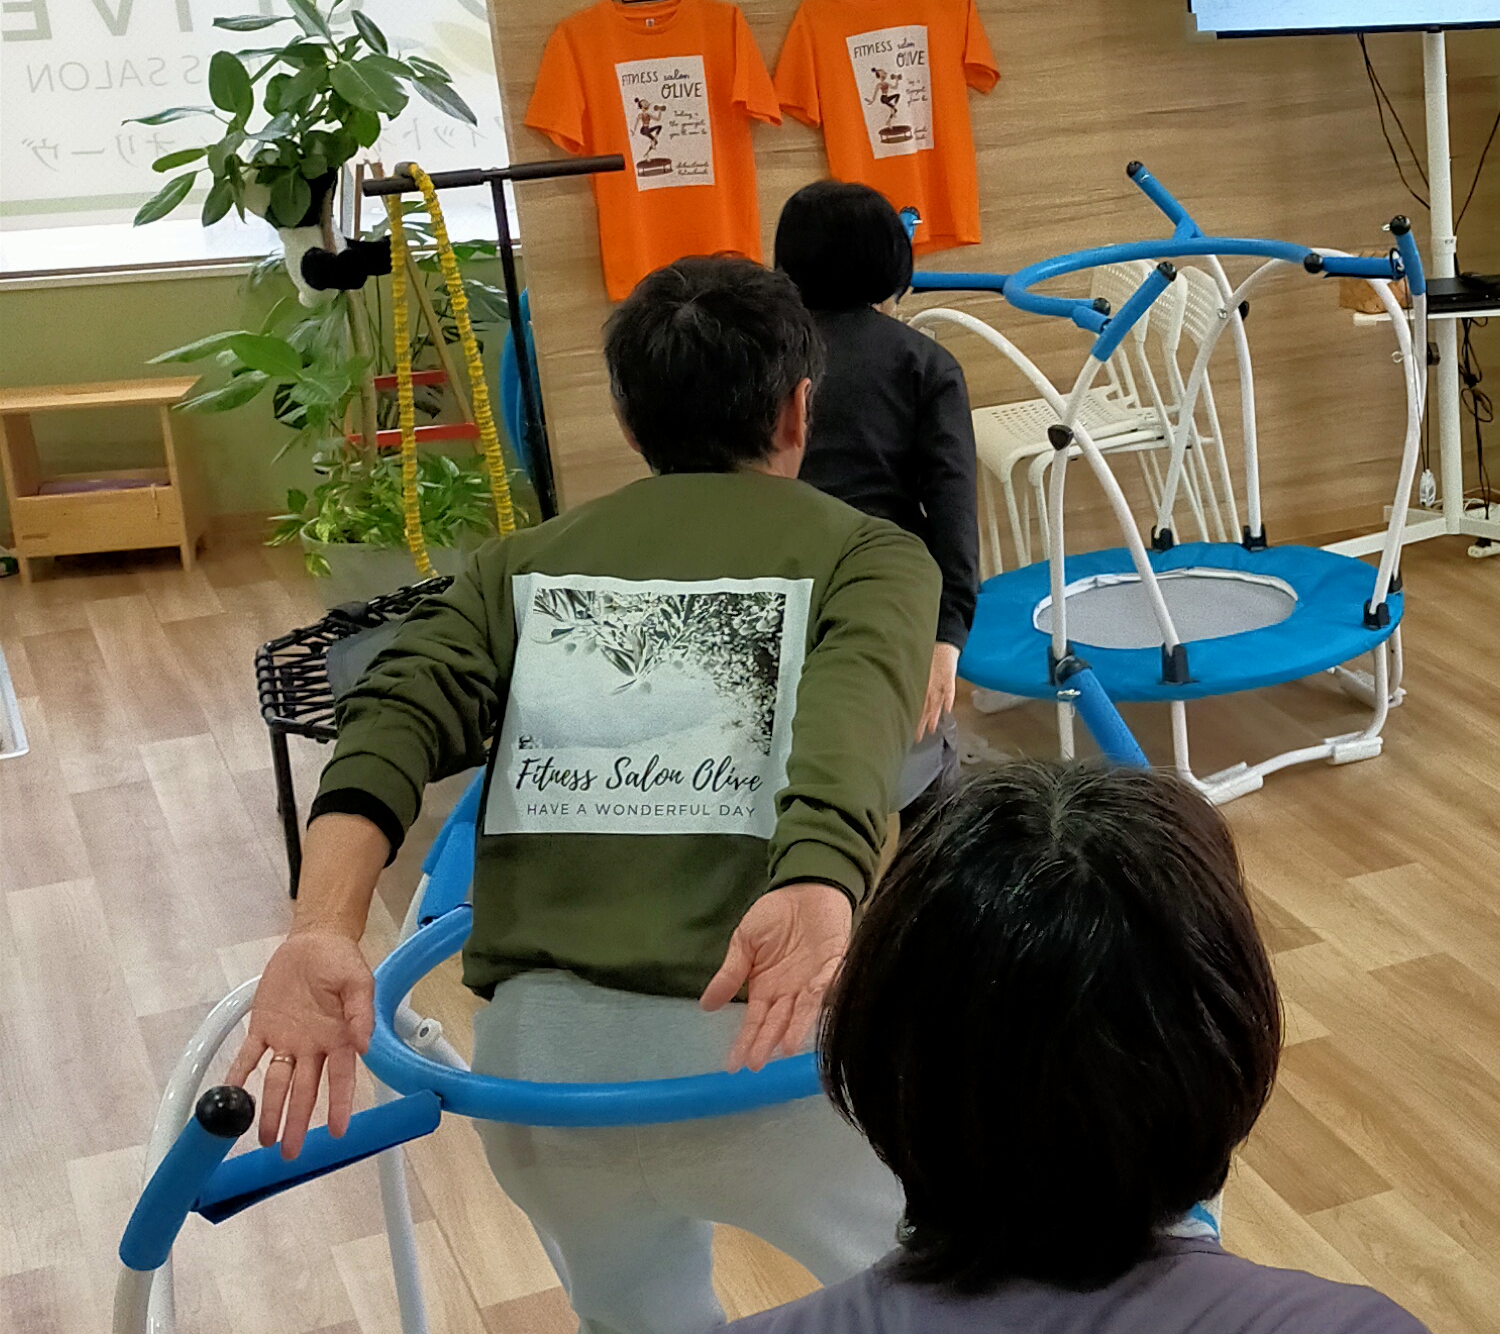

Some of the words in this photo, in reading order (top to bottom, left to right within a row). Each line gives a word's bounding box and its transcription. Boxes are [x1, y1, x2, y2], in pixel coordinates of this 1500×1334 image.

[853, 40, 893, 58] FITNESS
[621, 71, 659, 86] FITNESS
[661, 82, 702, 99] OLIVE
[516, 756, 598, 792] Fitness
[606, 754, 685, 792] Salon
[692, 755, 763, 792] Olive
[527, 803, 570, 816] HAVE
[576, 803, 587, 816] A
[596, 803, 711, 817] WONDERFUL
[719, 804, 756, 817] DAY
